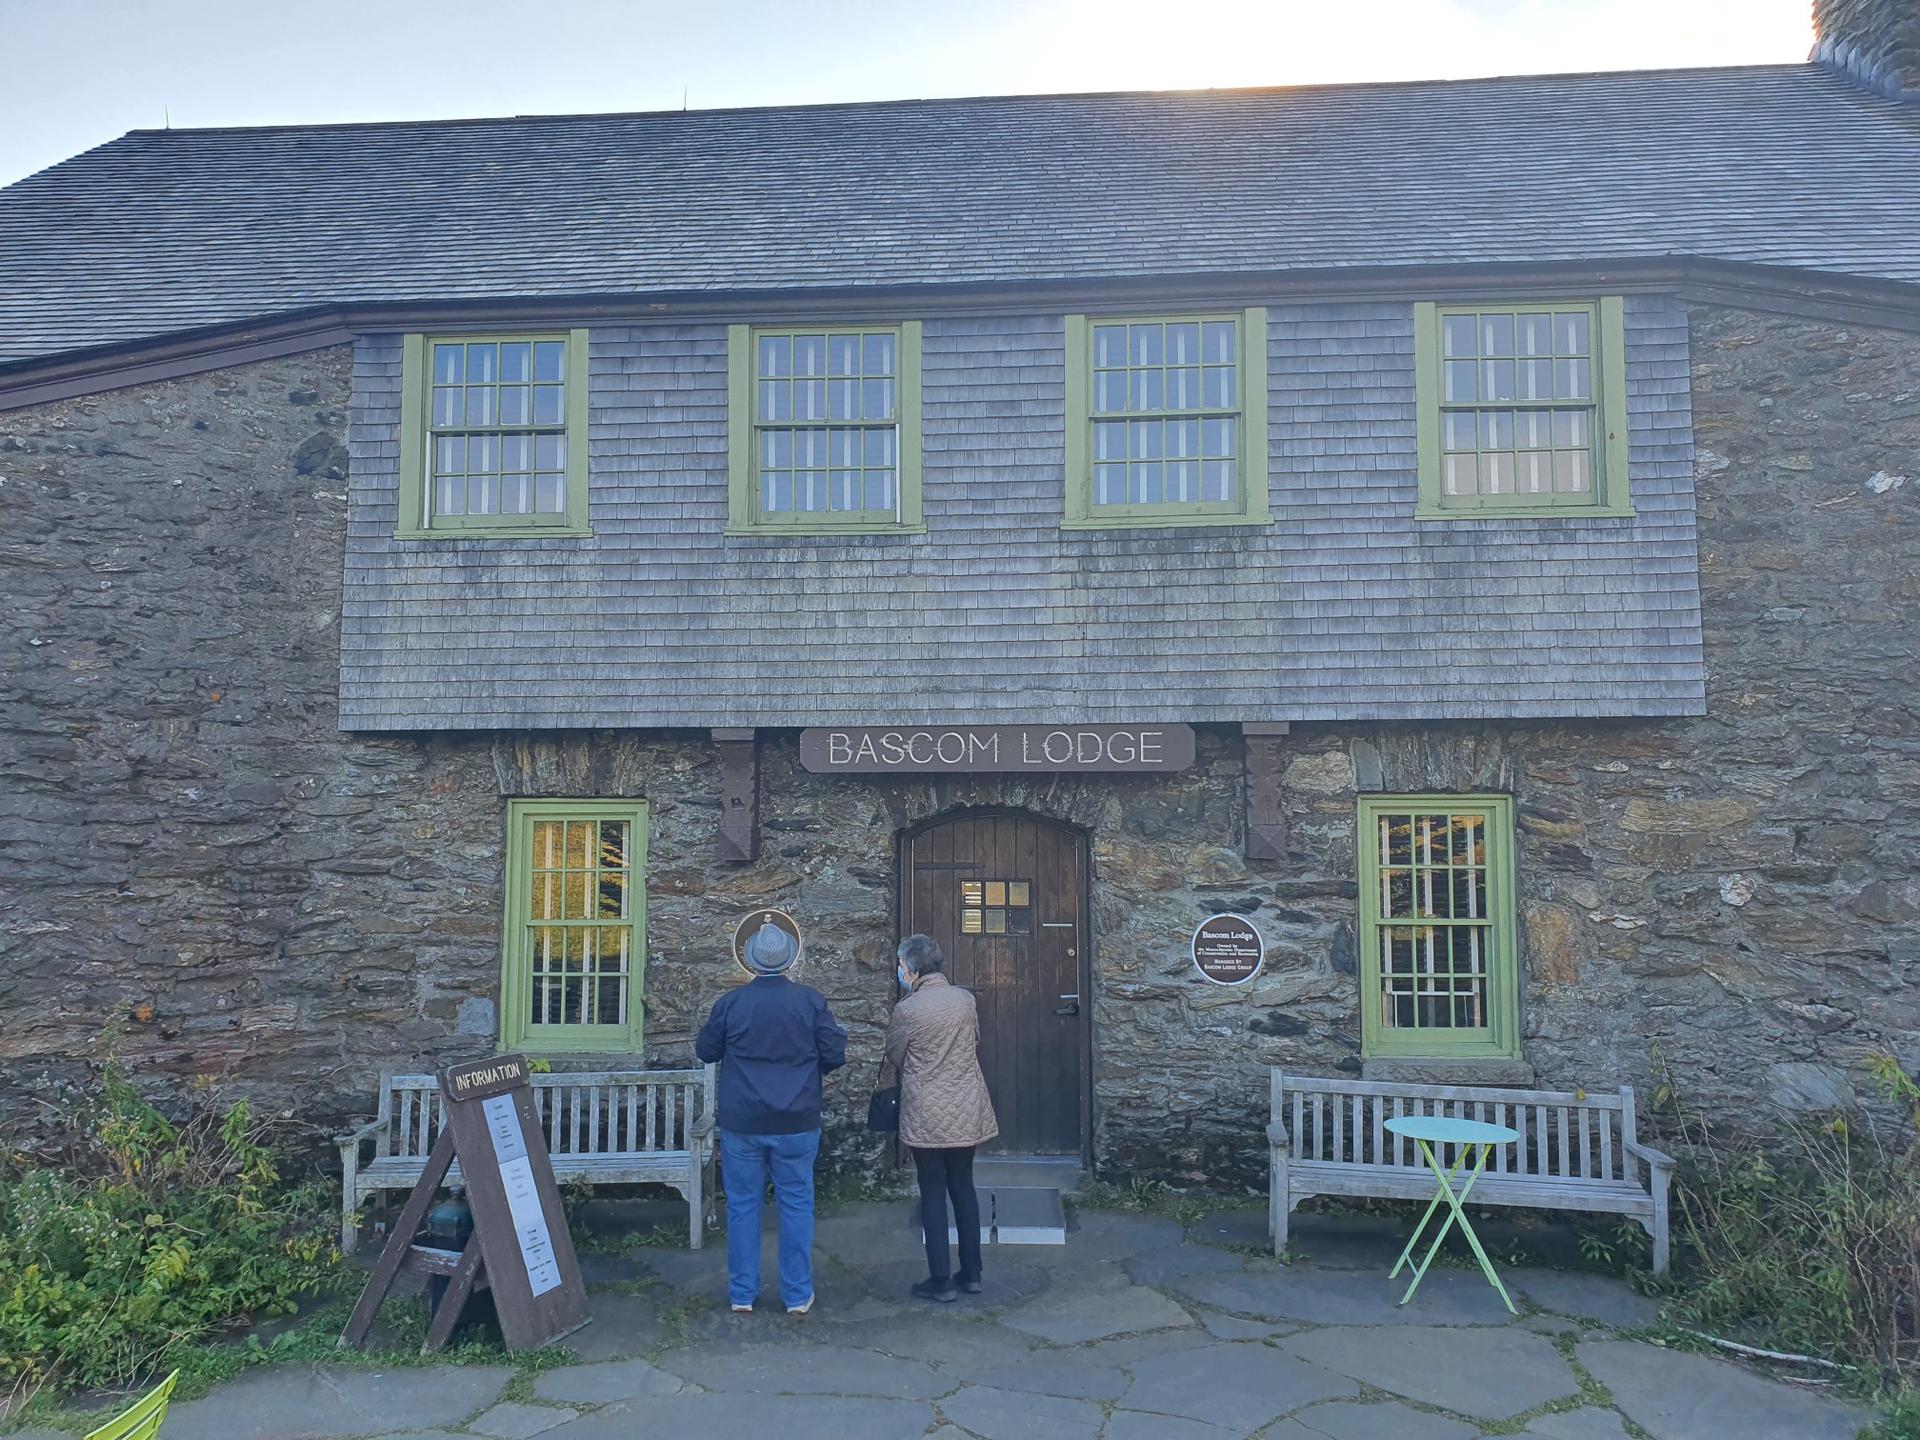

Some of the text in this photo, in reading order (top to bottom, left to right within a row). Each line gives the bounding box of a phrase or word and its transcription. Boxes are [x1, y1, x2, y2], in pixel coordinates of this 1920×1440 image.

[828, 732, 1164, 764] BASCOM LODGE
[1202, 931, 1253, 941] Bascom Lodge
[455, 1062, 521, 1091] INFORMATION
